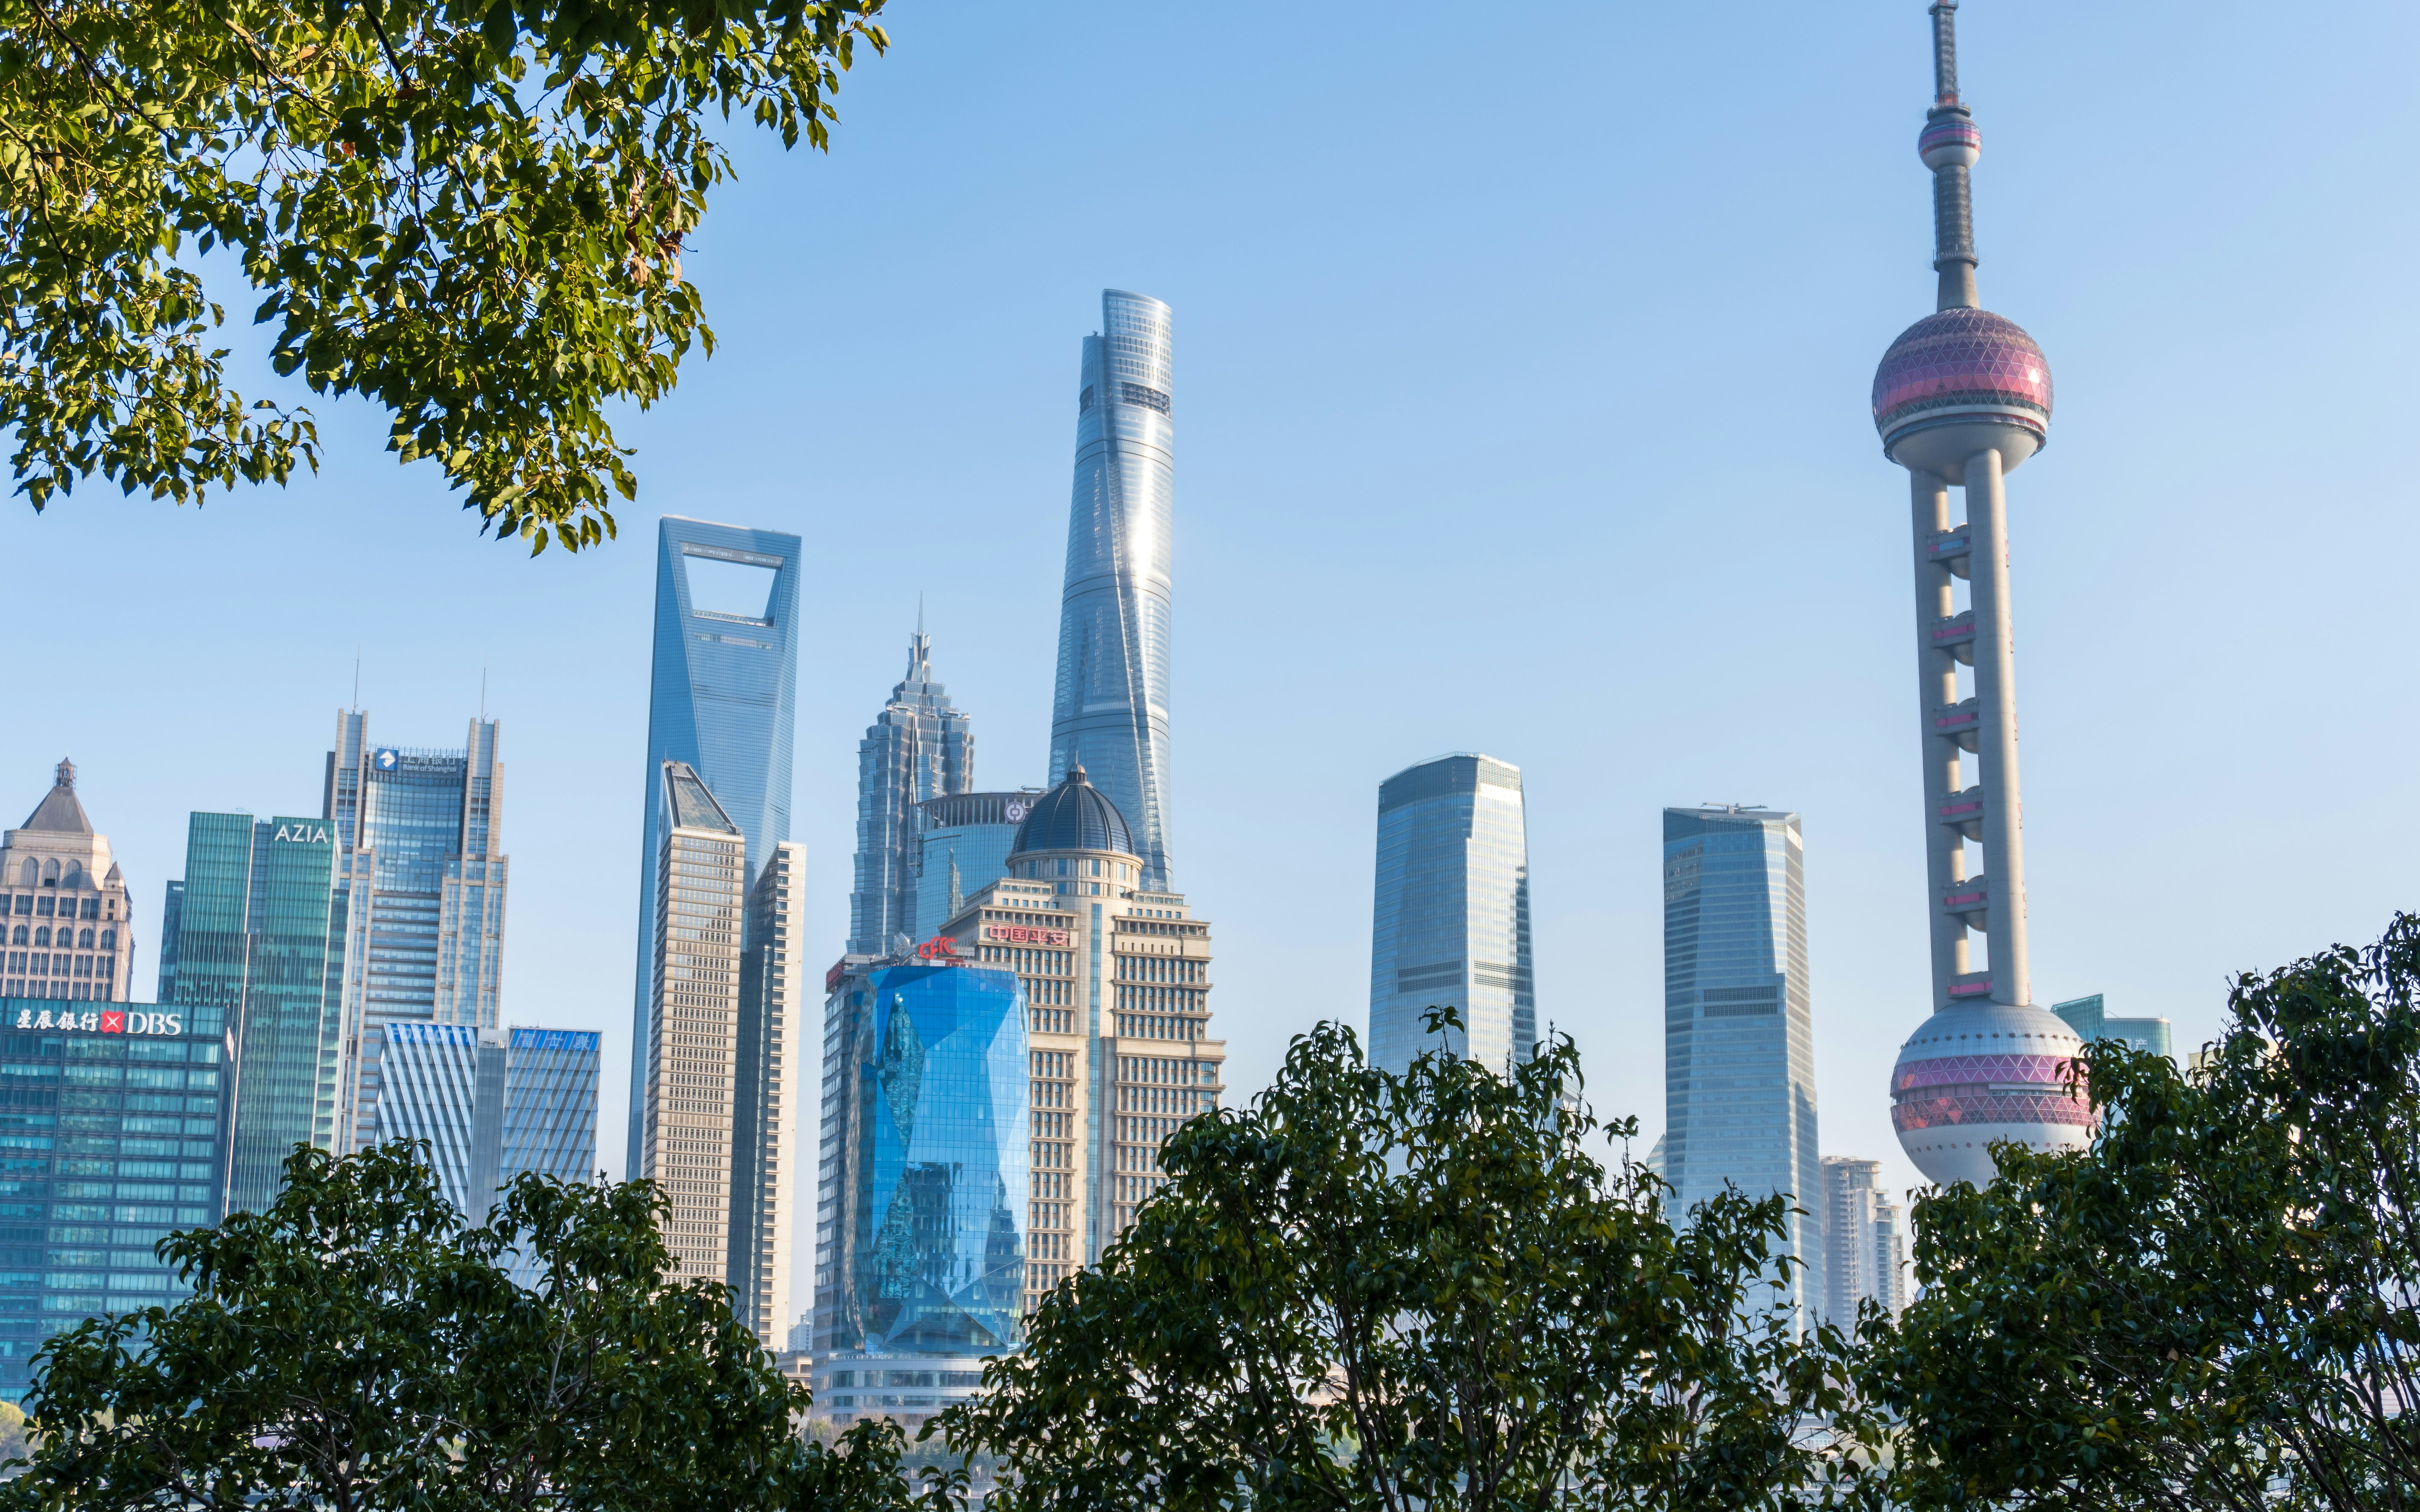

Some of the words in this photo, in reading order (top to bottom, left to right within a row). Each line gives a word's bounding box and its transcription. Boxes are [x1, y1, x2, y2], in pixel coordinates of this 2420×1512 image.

[404, 754, 457, 765] 上海银行
[274, 825, 328, 844] AZIA
[989, 925, 1069, 947] 中国平安
[127, 1012, 181, 1036] DBS
[520, 1032, 590, 1050] 富士康
